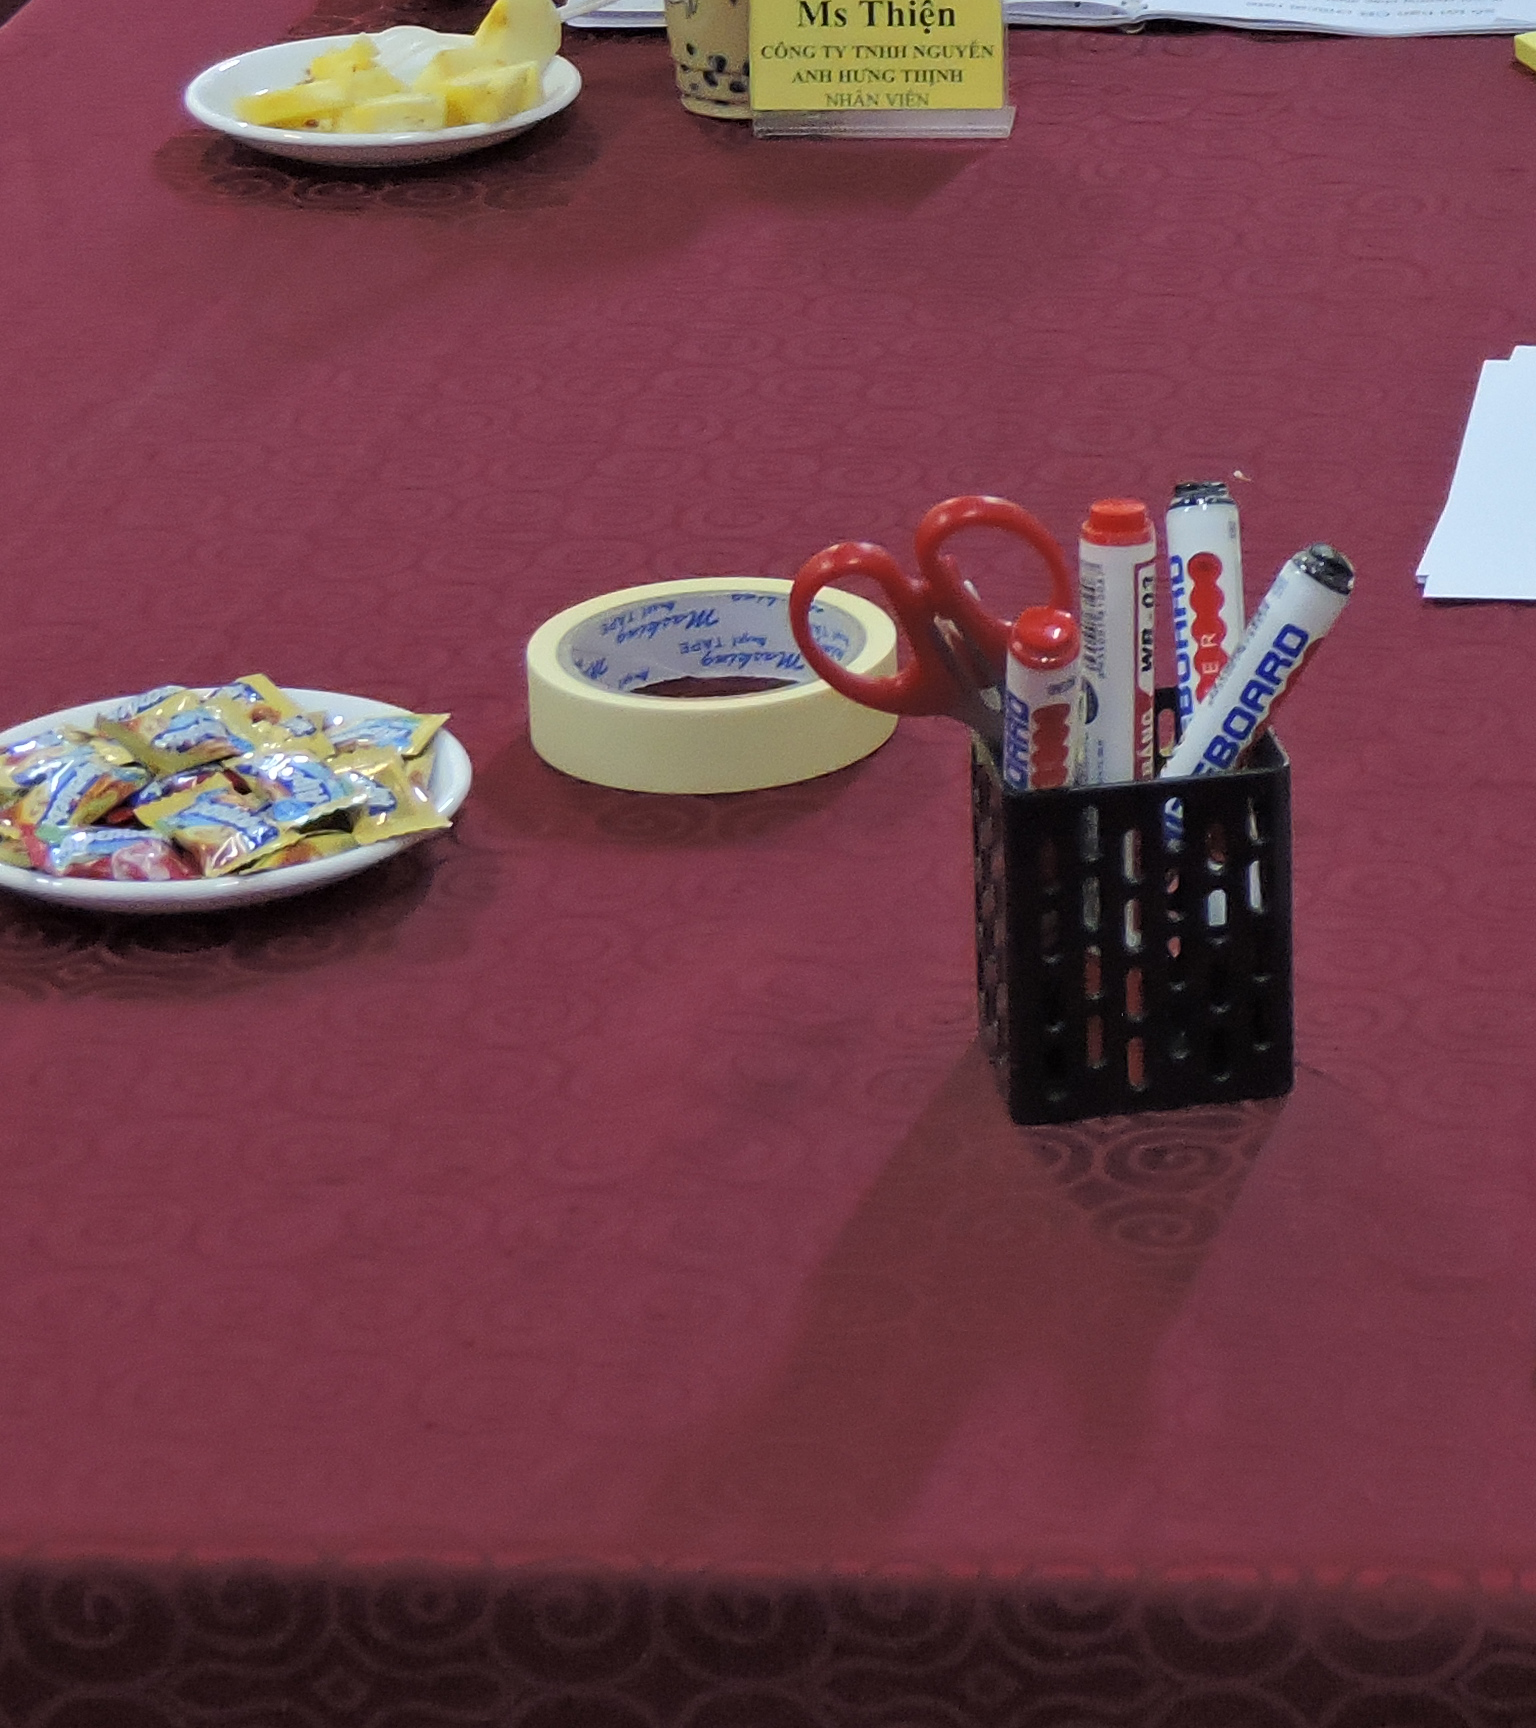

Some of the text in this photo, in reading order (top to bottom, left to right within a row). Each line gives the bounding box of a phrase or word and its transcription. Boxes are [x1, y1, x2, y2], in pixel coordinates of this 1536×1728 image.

[797, 0, 848, 28] Ms
[761, 41, 816, 60] CÔNG
[823, 44, 848, 60] TY
[852, 44, 907, 60] TNHH
[791, 68, 832, 84] ANH
[826, 88, 930, 108] NHÂN VIÊN
[615, 607, 720, 645] Masking
[679, 638, 723, 655] TAPE
[701, 649, 806, 670] Masking
